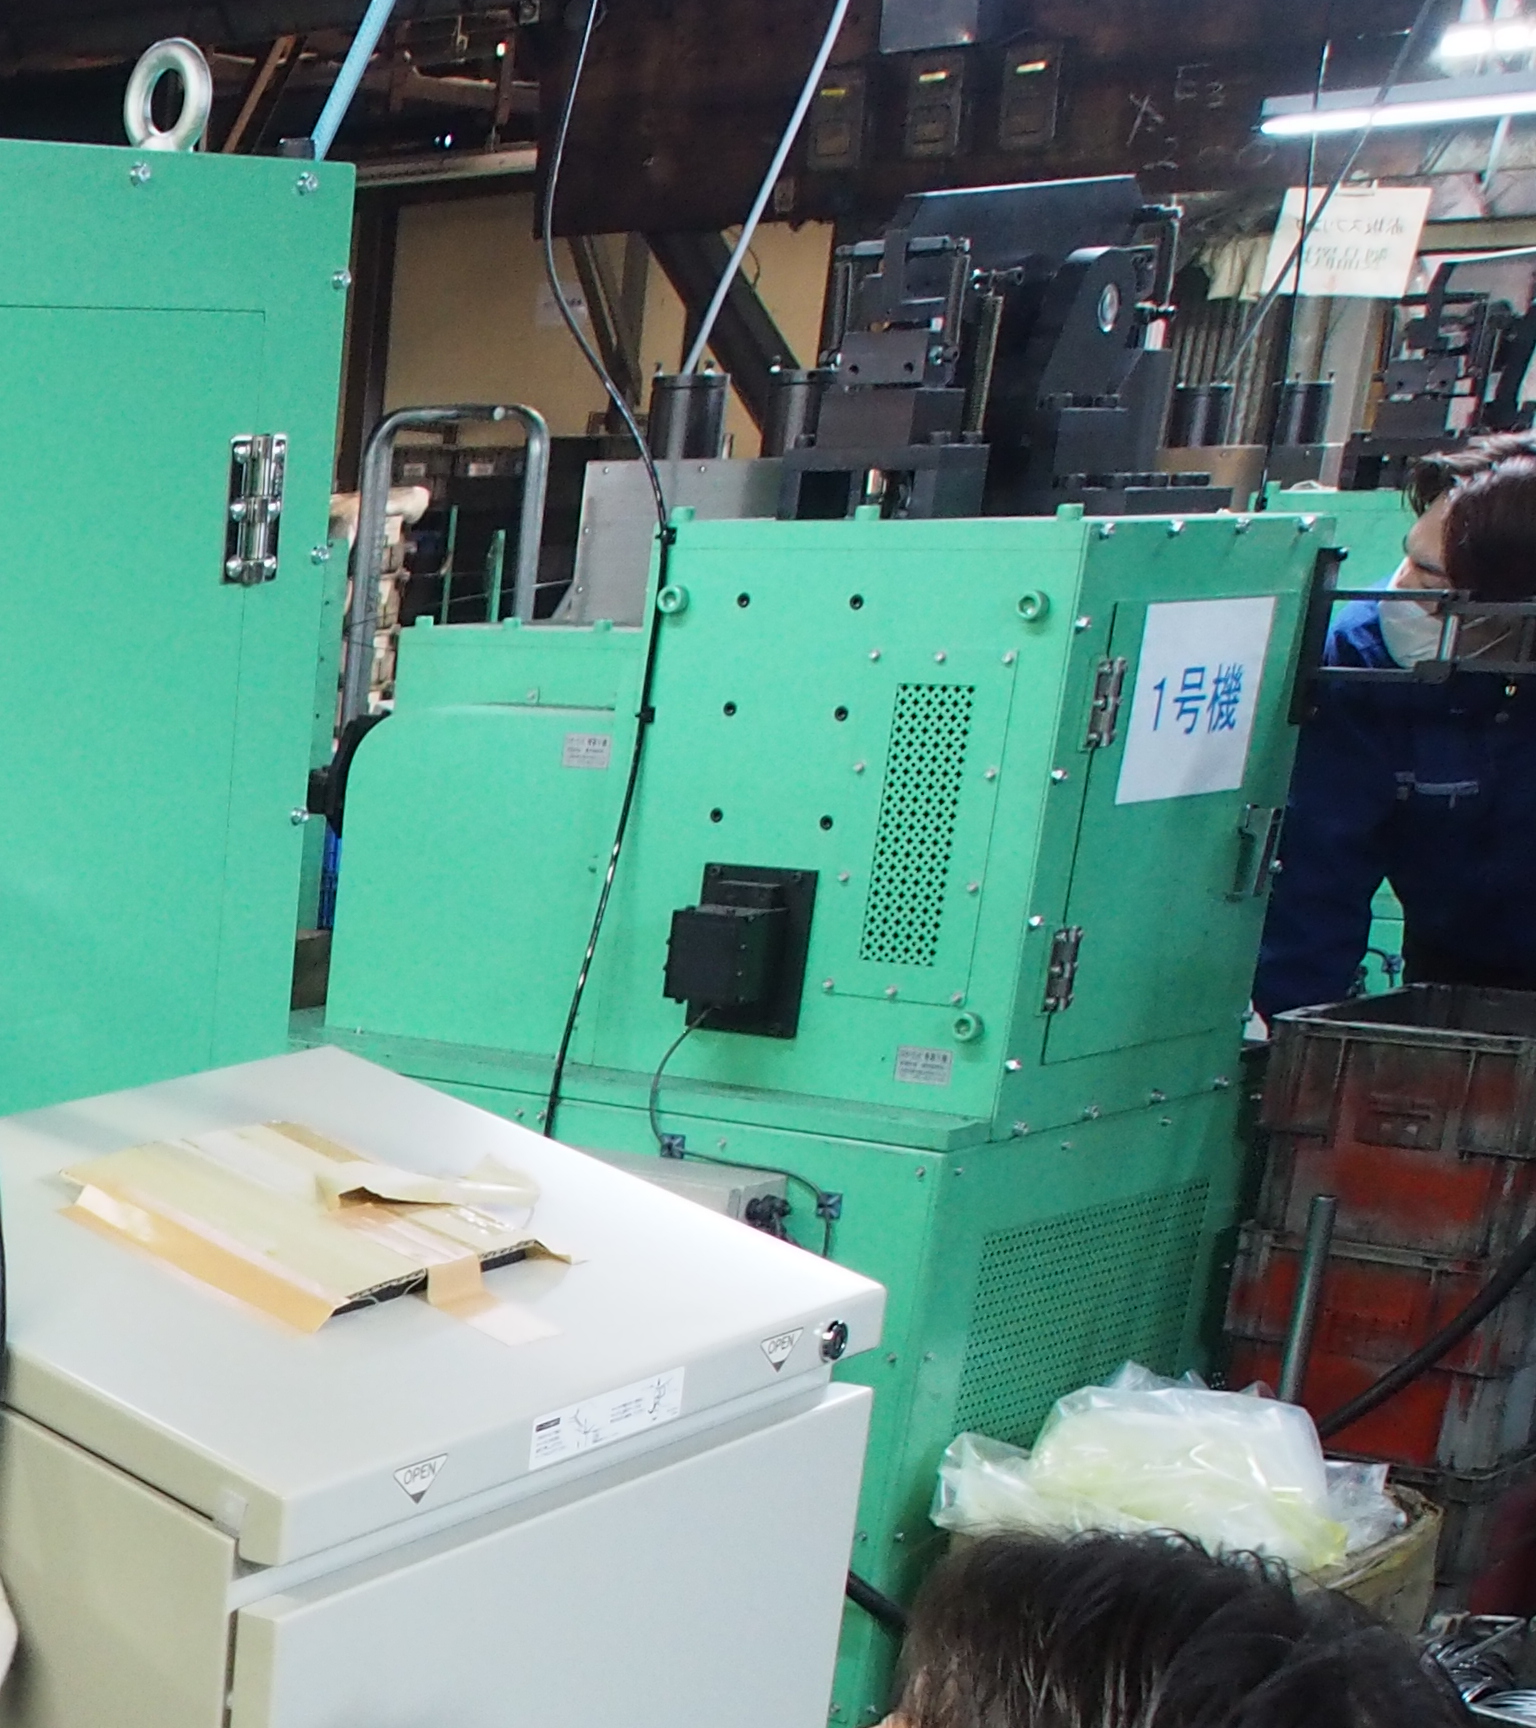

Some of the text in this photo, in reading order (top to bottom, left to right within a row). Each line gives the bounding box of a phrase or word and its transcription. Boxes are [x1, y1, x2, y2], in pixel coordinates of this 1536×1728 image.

[1153, 661, 1244, 735] 1号機
[769, 1334, 794, 1354] OPEN
[404, 1461, 436, 1484] OPEN
